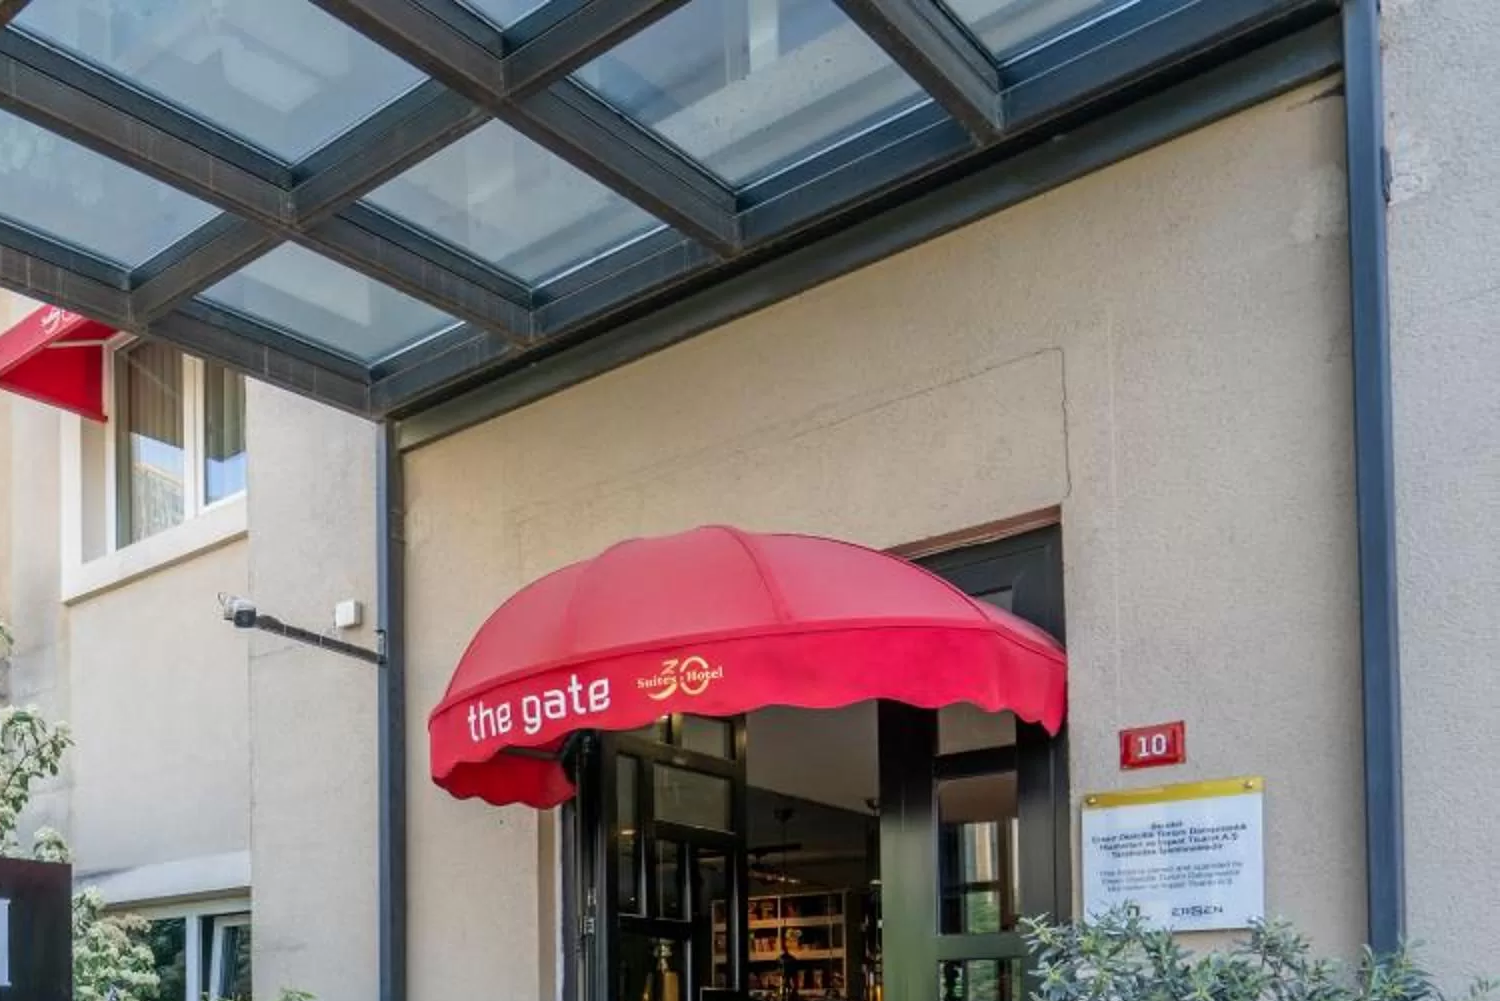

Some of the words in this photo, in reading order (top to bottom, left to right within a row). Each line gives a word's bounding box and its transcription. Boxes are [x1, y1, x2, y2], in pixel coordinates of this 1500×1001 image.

[685, 664, 724, 682] Hotel
[467, 700, 513, 743] the
[521, 673, 612, 736] gate
[1137, 733, 1167, 757] 10
